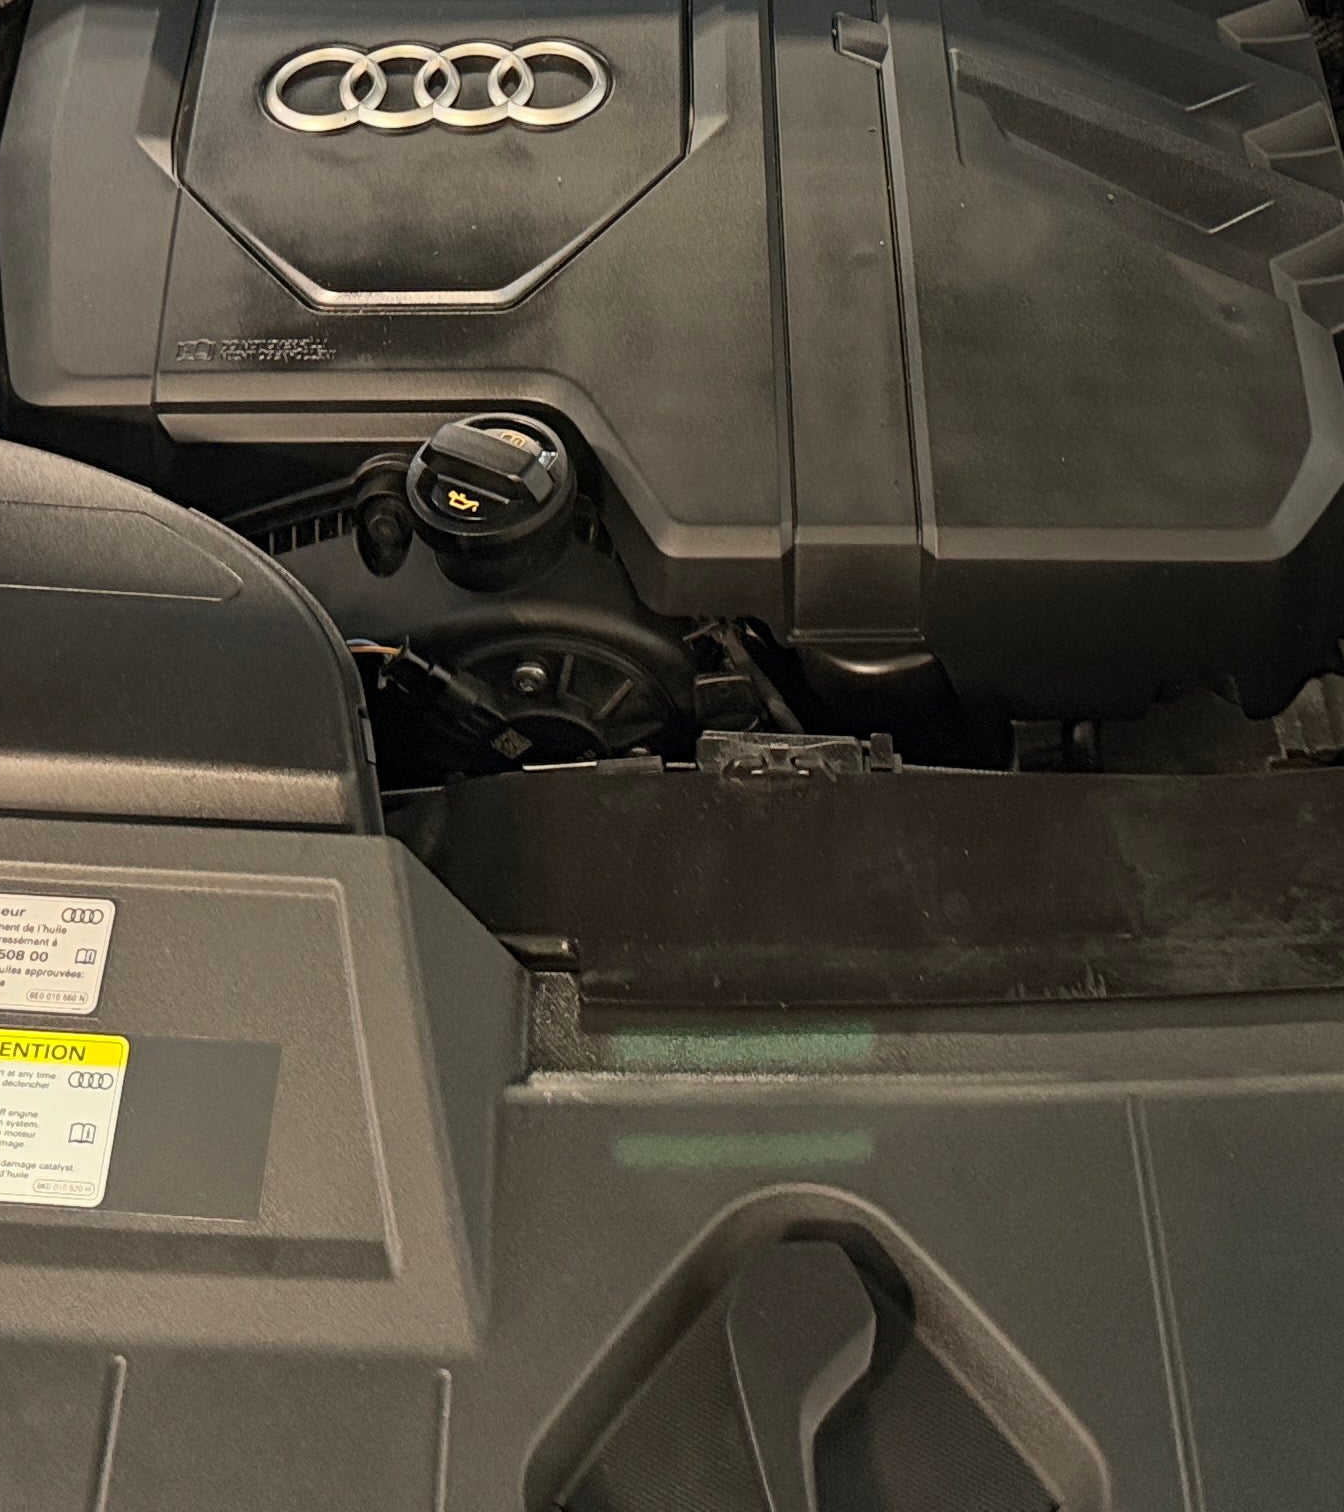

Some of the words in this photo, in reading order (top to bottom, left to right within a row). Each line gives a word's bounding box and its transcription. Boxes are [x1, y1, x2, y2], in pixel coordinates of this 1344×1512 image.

[23, 924, 34, 933] de
[37, 924, 67, 934] l'huile
[30, 951, 49, 962] 00
[25, 967, 85, 979] approuvées:
[18, 1071, 34, 1080] any
[8, 1110, 39, 1119] engine
[4, 1130, 36, 1138] moteur
[0, 1159, 37, 1170] damage
